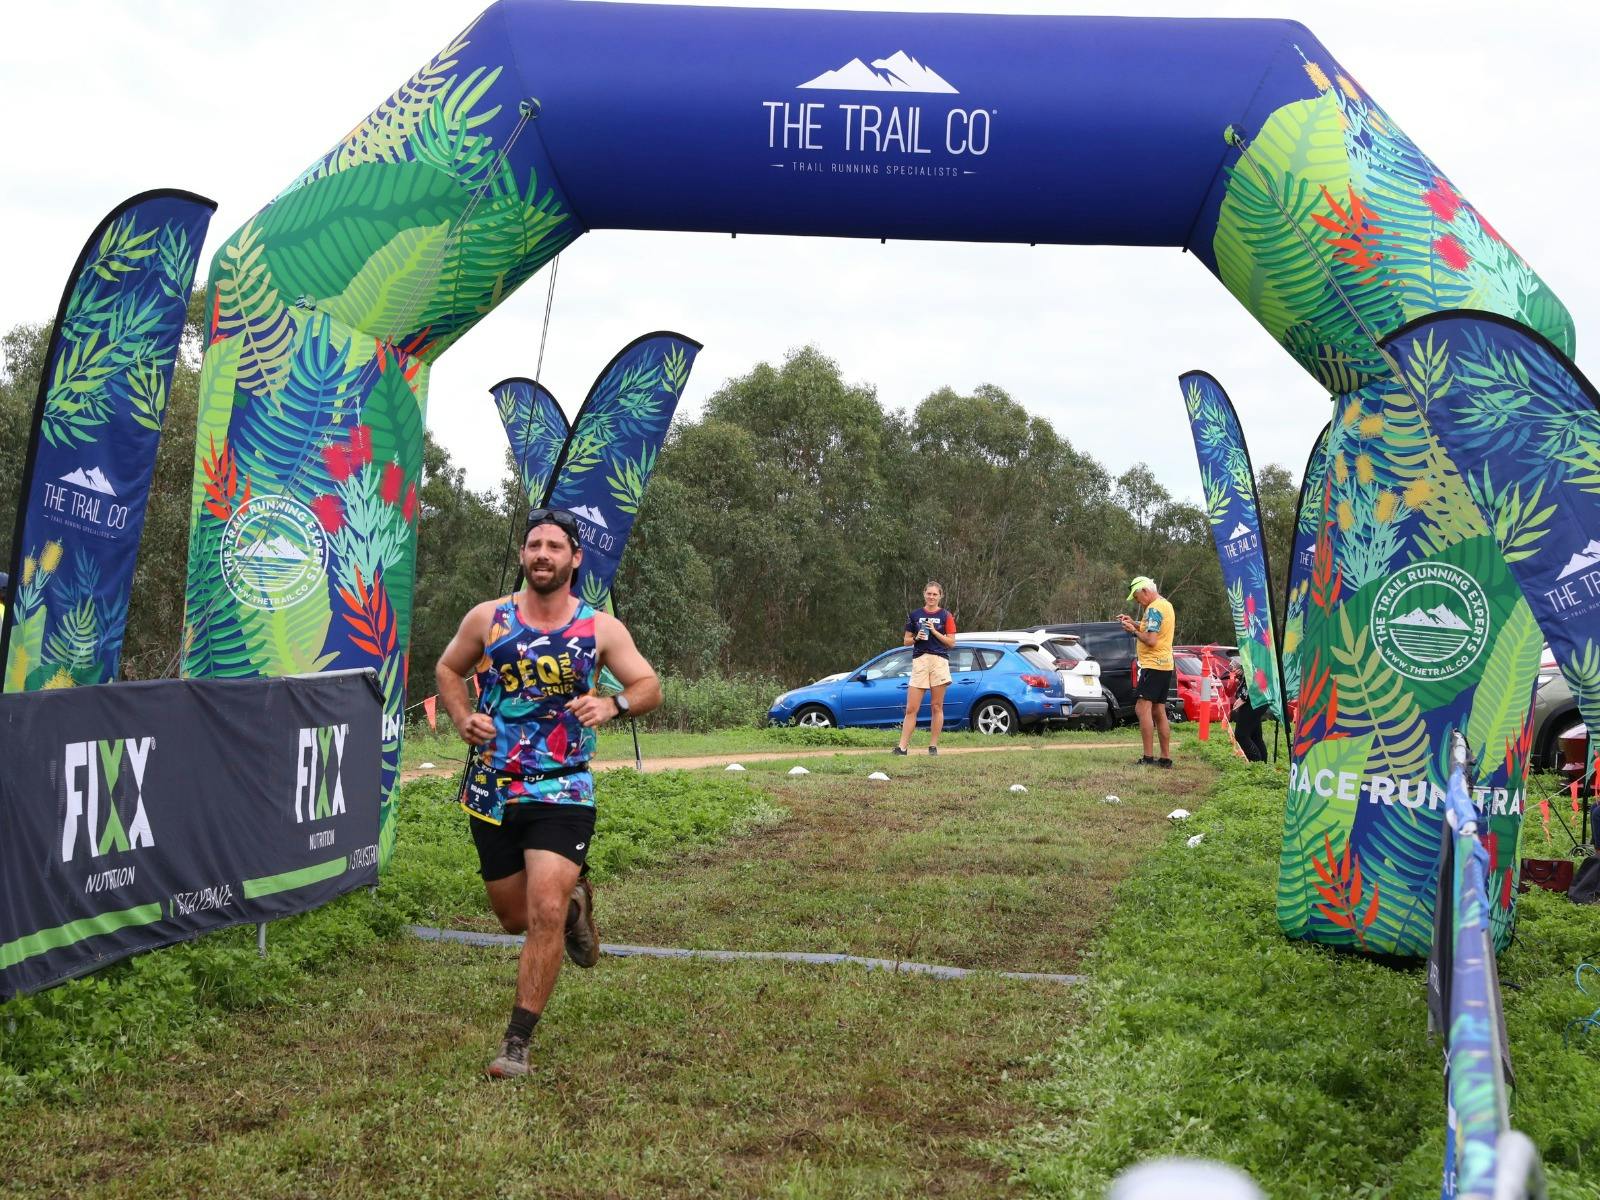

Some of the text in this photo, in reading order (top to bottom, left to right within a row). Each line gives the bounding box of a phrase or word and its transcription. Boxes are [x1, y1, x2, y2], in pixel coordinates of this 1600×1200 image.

[763, 101, 990, 155] THE TRAIL CO
[792, 161, 958, 177] TRAIL RUNNING SPECIALISTS
[44, 482, 128, 530] THE TRAIL CO
[225, 500, 323, 582] THE TRAIL RUNNING EXPERTS
[1224, 543, 1238, 558] THE
[1299, 551, 1310, 566] THE
[1543, 581, 1582, 613] THE
[1579, 570, 1600, 598] TR
[1375, 567, 1485, 653] THE TRAIL RUNNING EXPERTS
[500, 655, 561, 693] SEQ
[470, 784, 489, 797] BRAVO
[474, 794, 480, 802] 2
[1473, 785, 1525, 817] TRA
[309, 829, 335, 851] NUTRITION
[85, 865, 136, 894] NUTRITION
